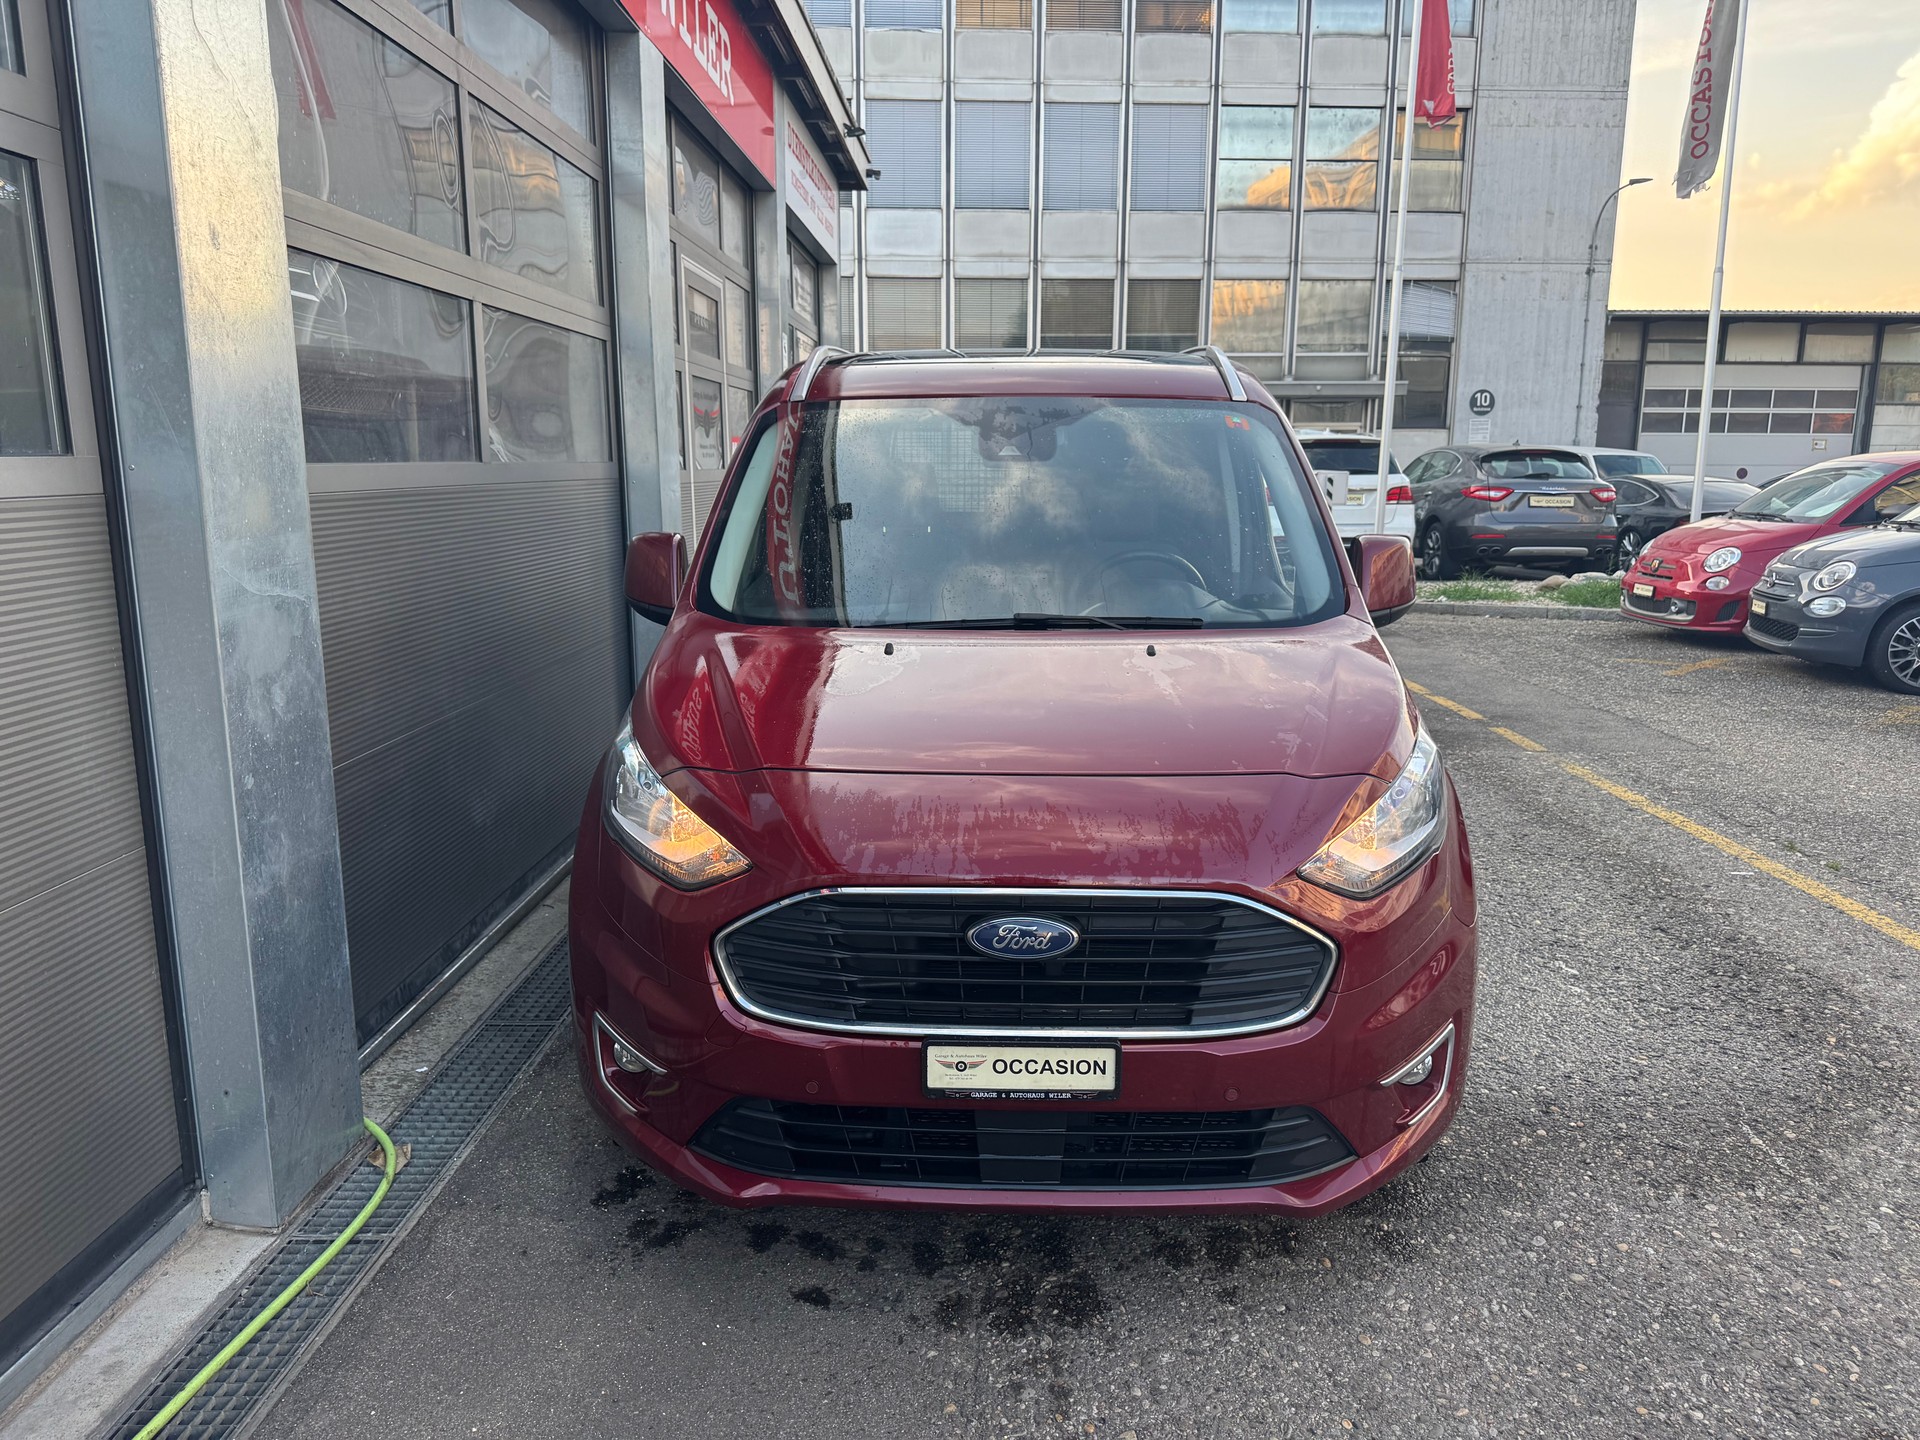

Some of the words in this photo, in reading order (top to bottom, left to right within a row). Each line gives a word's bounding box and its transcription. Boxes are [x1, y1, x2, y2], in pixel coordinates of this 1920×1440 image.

[1474, 391, 1491, 406] 10
[992, 924, 1052, 950] Ford
[992, 1058, 1107, 1076] OCCASION
[970, 1091, 998, 1099] GARAGE
